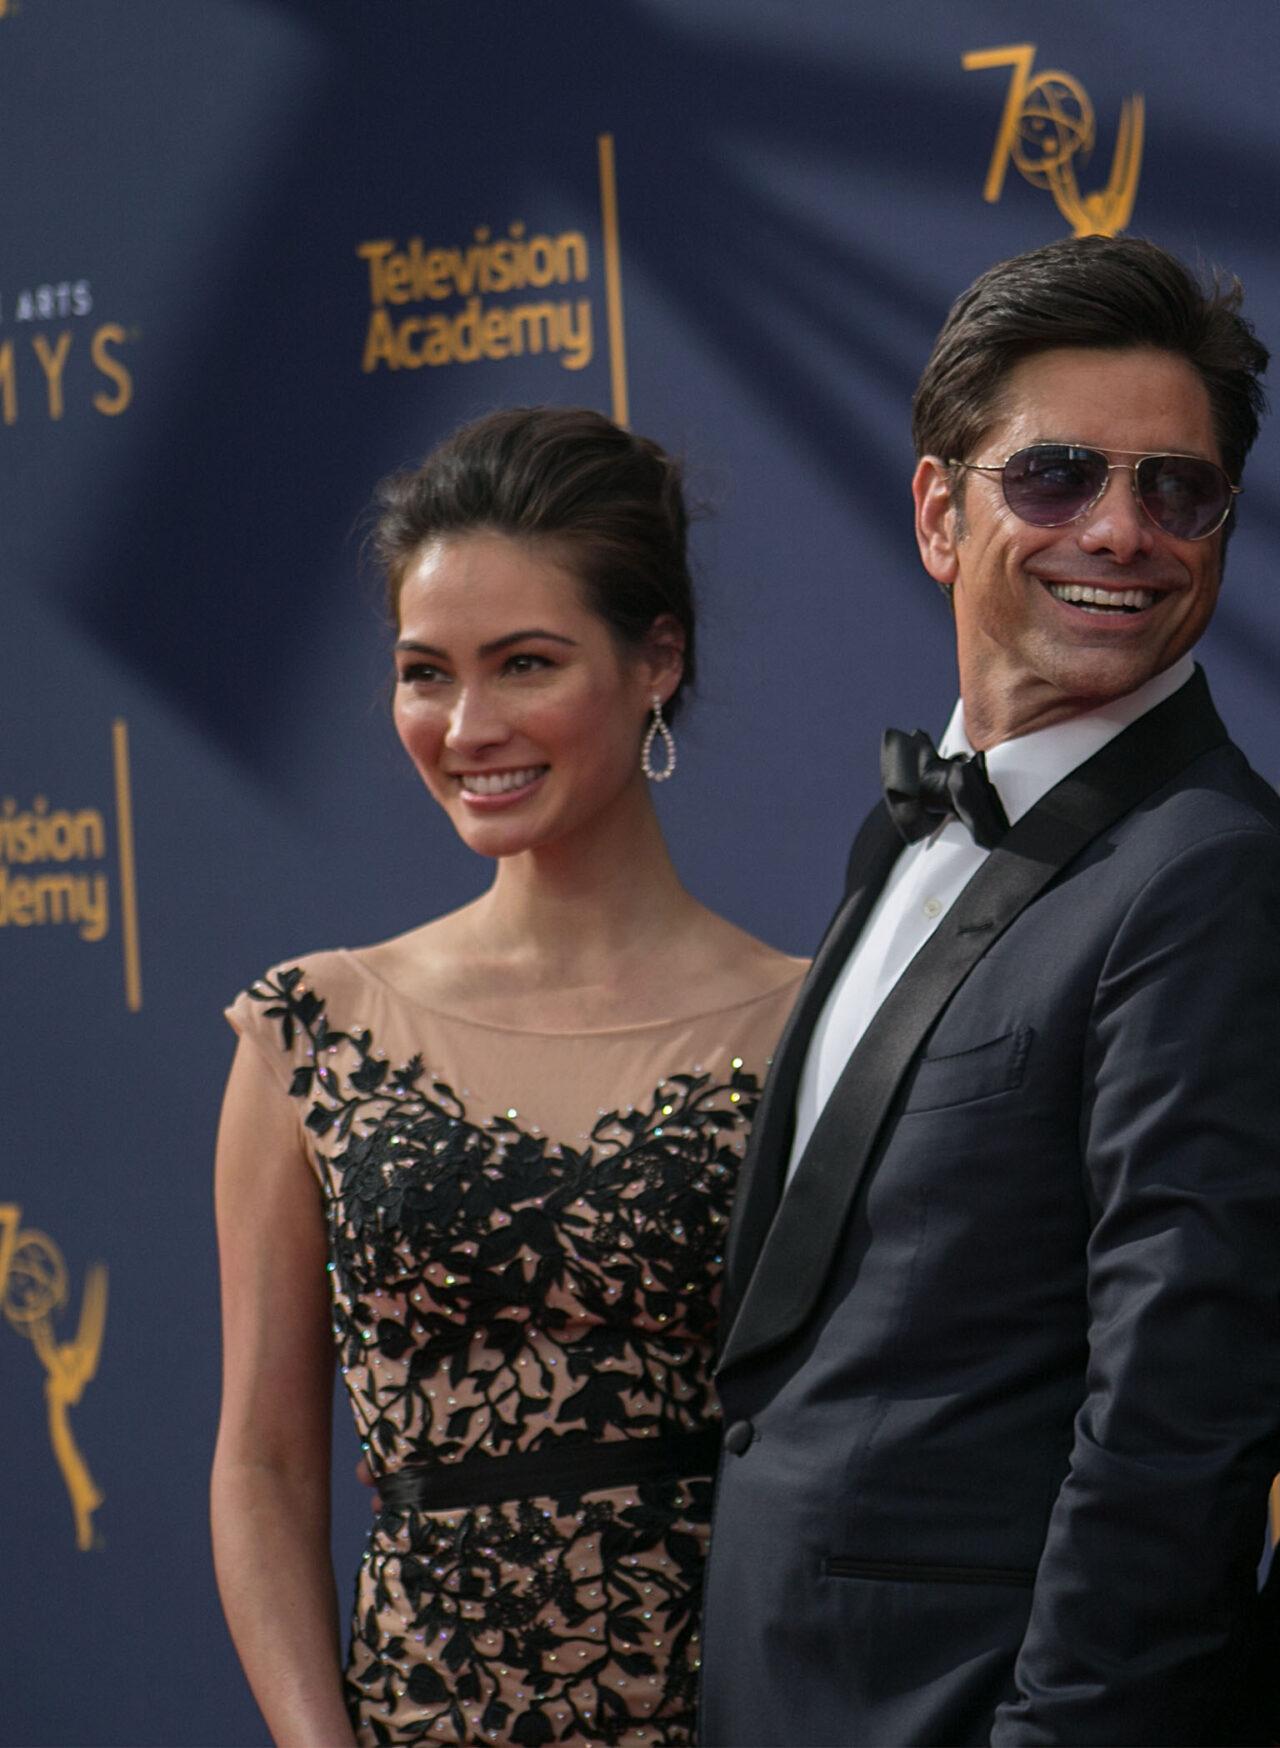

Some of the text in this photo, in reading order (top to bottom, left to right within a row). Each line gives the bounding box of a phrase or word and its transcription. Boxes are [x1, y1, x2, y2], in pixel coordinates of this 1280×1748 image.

[16, 278, 93, 321] ARTS
[356, 219, 589, 304] Television
[361, 296, 593, 374] Academy
